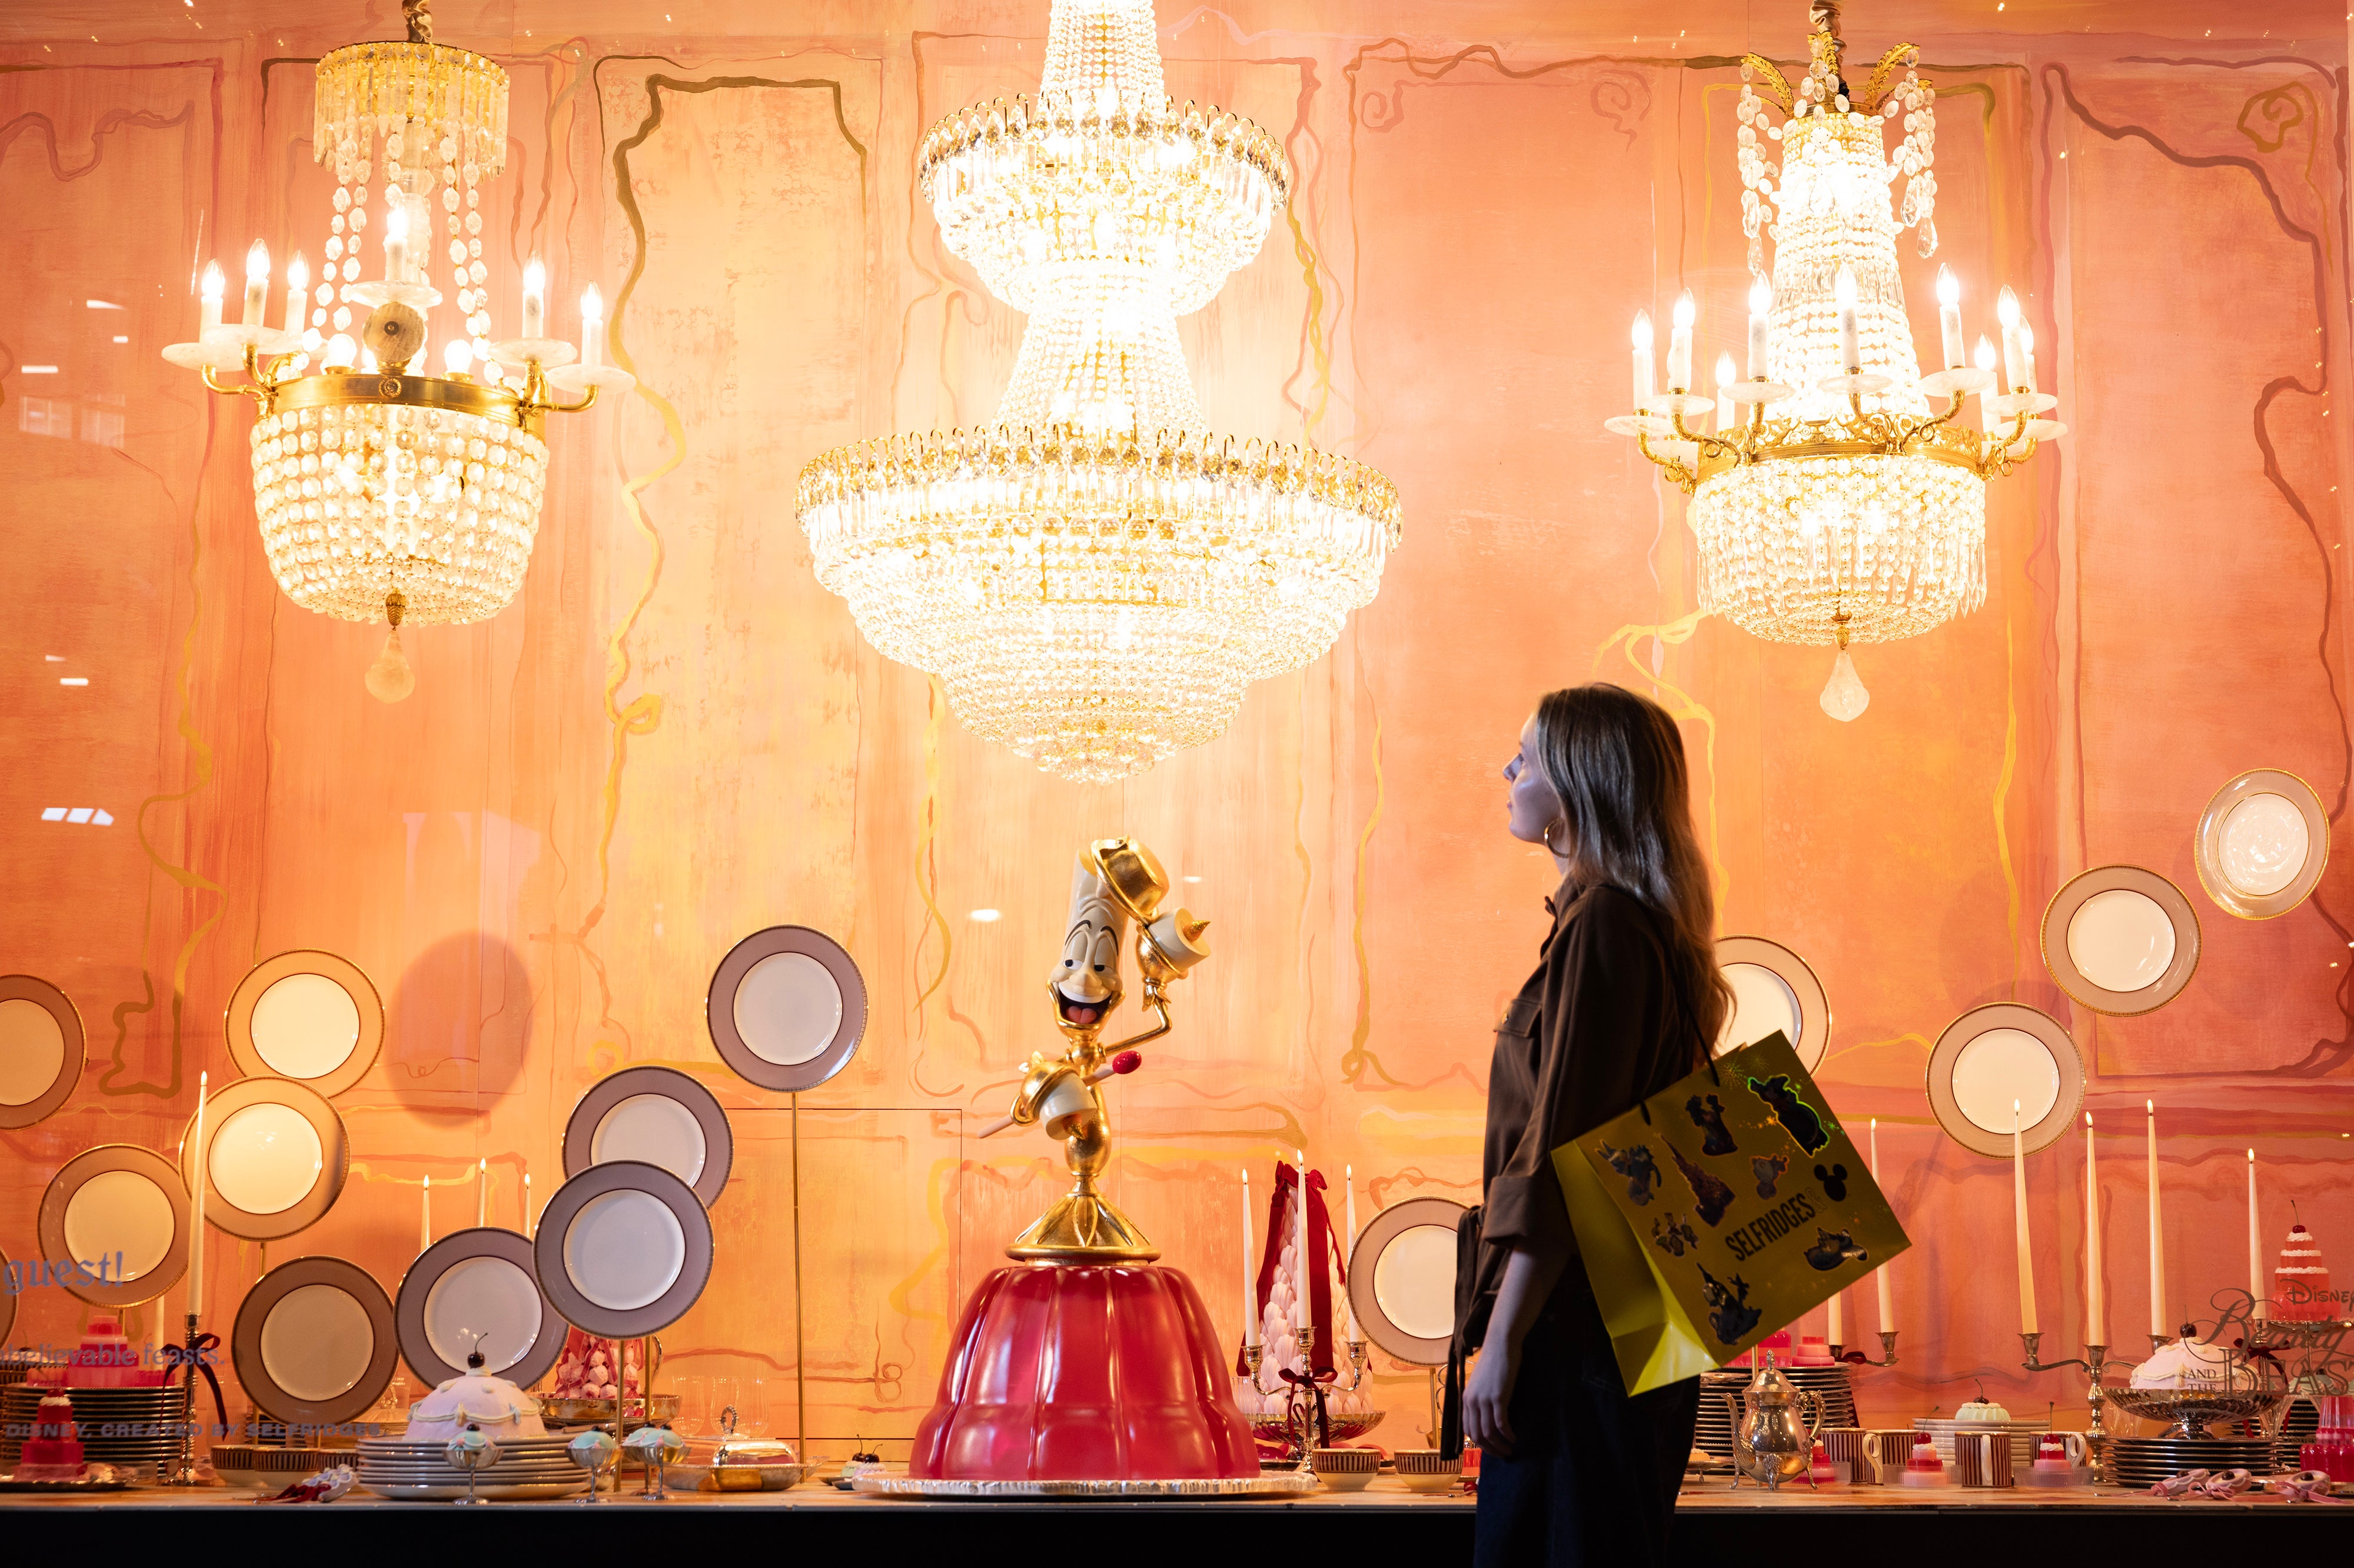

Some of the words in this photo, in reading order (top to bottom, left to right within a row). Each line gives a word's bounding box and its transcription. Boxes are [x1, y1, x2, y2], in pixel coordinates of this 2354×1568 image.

[4, 1251, 124, 1296] guest!
[2184, 1288, 2354, 1377] Beauty
[142, 1343, 225, 1366] feasts.
[2188, 1369, 2216, 1379] AND
[2187, 1383, 2217, 1395] THE
[5, 1423, 92, 1439] DISNEY,
[100, 1423, 202, 1437] CREATED
[212, 1423, 239, 1437] BY
